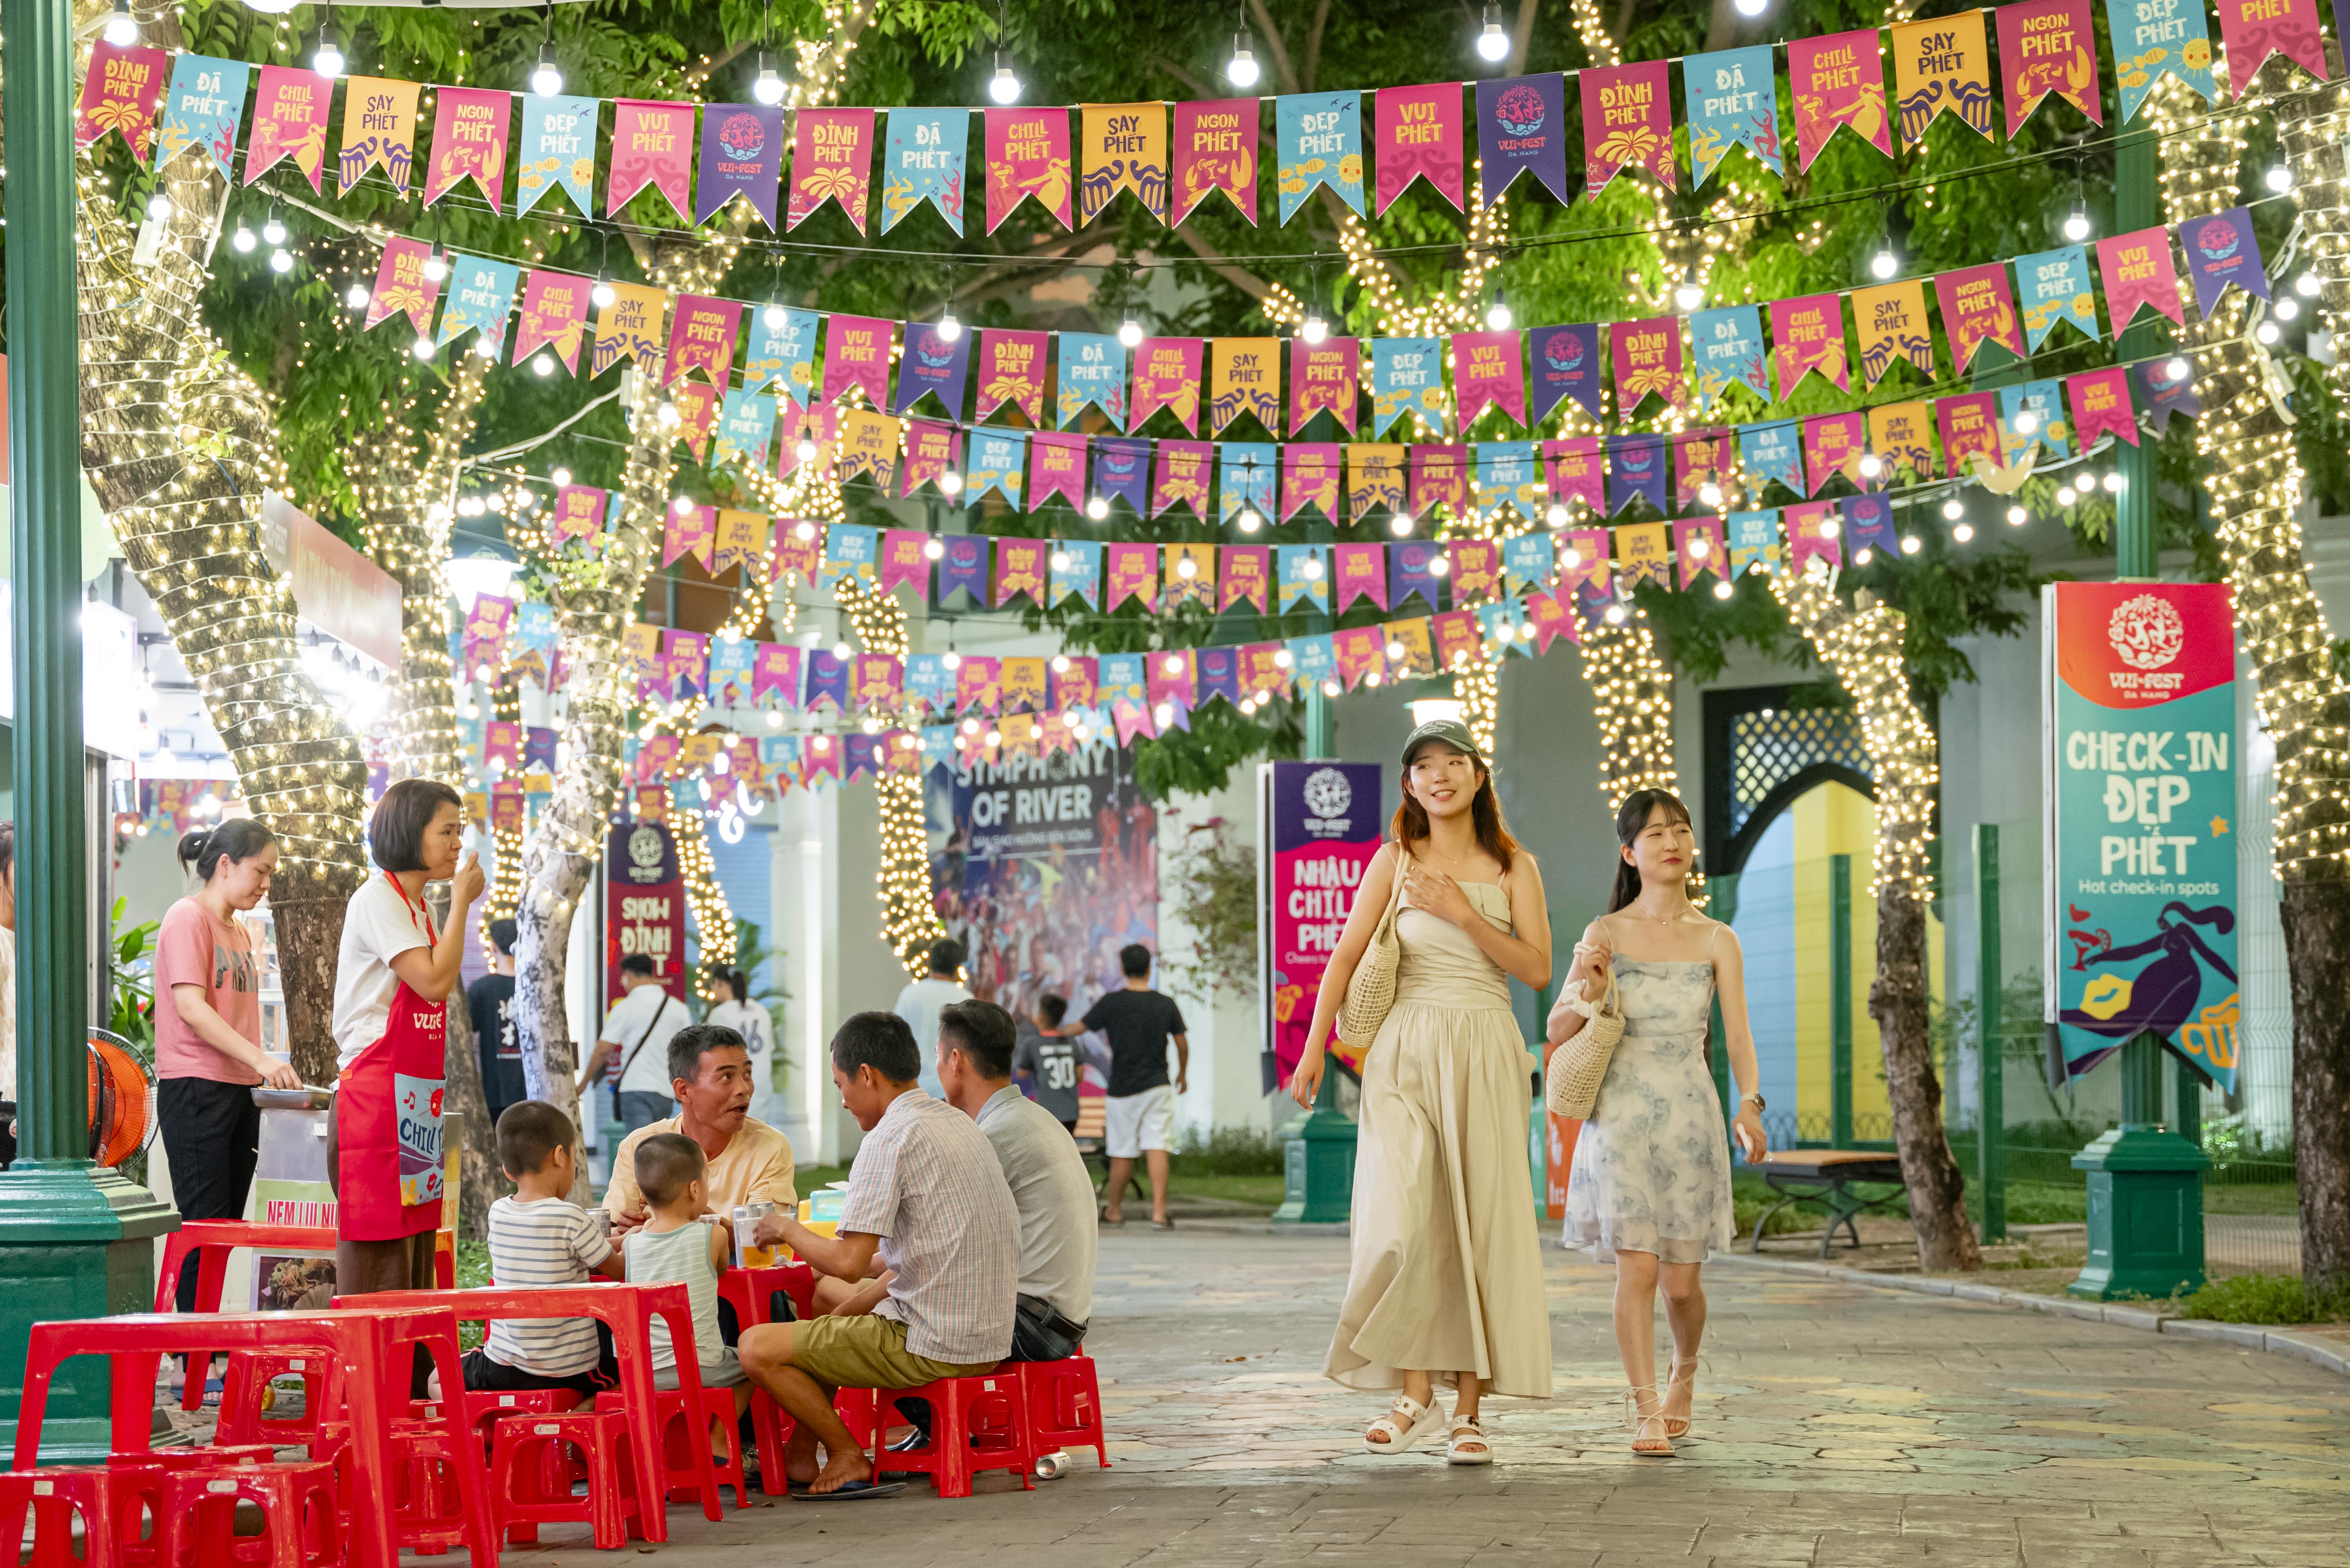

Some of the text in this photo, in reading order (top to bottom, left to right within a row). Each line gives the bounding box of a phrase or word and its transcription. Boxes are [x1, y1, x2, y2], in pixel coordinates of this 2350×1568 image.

[2136, 0, 2178, 23] ĐẸP
[2023, 13, 2069, 33] NGON
[1921, 32, 1955, 56] SAY
[2021, 30, 2075, 57] PHẾT
[1813, 45, 1856, 69] CHILL
[1918, 50, 1964, 74] PHẾT
[105, 55, 149, 83] ĐỈNH
[1715, 64, 1745, 90] ĐÃ
[1811, 64, 1860, 91] PHẾT
[104, 78, 144, 98] PHẾT
[197, 72, 222, 94] ĐÃ
[279, 85, 313, 103] CHILL
[367, 95, 395, 112] SAY
[1600, 80, 1652, 108] ĐỈNH
[1704, 88, 1758, 117] PHẾT
[181, 94, 228, 116] PHẾT
[273, 101, 313, 122] PHẾT
[457, 105, 493, 120] NGON
[1399, 103, 1436, 123] VUI
[1605, 102, 1650, 126] PHẾT
[363, 113, 398, 130] PHẾT
[452, 119, 495, 142] PHẾT
[544, 114, 577, 133] ĐẸP
[638, 113, 670, 131] VUI
[1009, 119, 1048, 139] CHILL
[1108, 115, 1139, 135] SAY
[1197, 114, 1238, 129] NGON
[1302, 112, 1340, 133] ĐẸP
[1396, 121, 1443, 143] PHẾT
[541, 132, 581, 154] PHẾT
[632, 131, 675, 152] PHẾT
[813, 119, 858, 146] ĐỈNH
[915, 122, 941, 145] ĐÃ
[1104, 133, 1146, 153] PHẾT
[1194, 129, 1242, 152] PHẾT
[1300, 131, 1345, 154] PHẾT
[814, 143, 854, 162] PHẾT
[1006, 137, 1051, 160] PHẾT
[1498, 137, 1546, 150] VUI-FEST
[718, 162, 763, 173] VUI-FEST
[902, 145, 951, 169] PHẾT
[395, 251, 427, 271] ĐỈN
[2117, 245, 2149, 266] VUI
[543, 286, 573, 302] CHILL
[1956, 279, 1992, 297] NGON
[620, 299, 644, 313] SAY
[1790, 308, 1824, 325] CHILL
[1875, 299, 1901, 317] SAY
[692, 311, 725, 325] NGON
[845, 330, 872, 346] VUI
[1153, 348, 1185, 362] CHILL
[1233, 354, 1259, 368] SAY
[1309, 351, 1343, 363] NGON
[1470, 345, 1500, 363] VUI
[2109, 672, 2184, 689] VUI-FEST
[2066, 730, 2228, 772] CHECK-IN
[972, 784, 1092, 827] OF RIVER
[2102, 774, 2190, 831] ĐẸP
[2100, 825, 2197, 876] PHẾT
[2079, 878, 2220, 897] Hot check-in spots
[622, 897, 670, 921] SHOW
[1043, 1056, 1076, 1090] 30
[400, 1117, 436, 1155] CHILL
